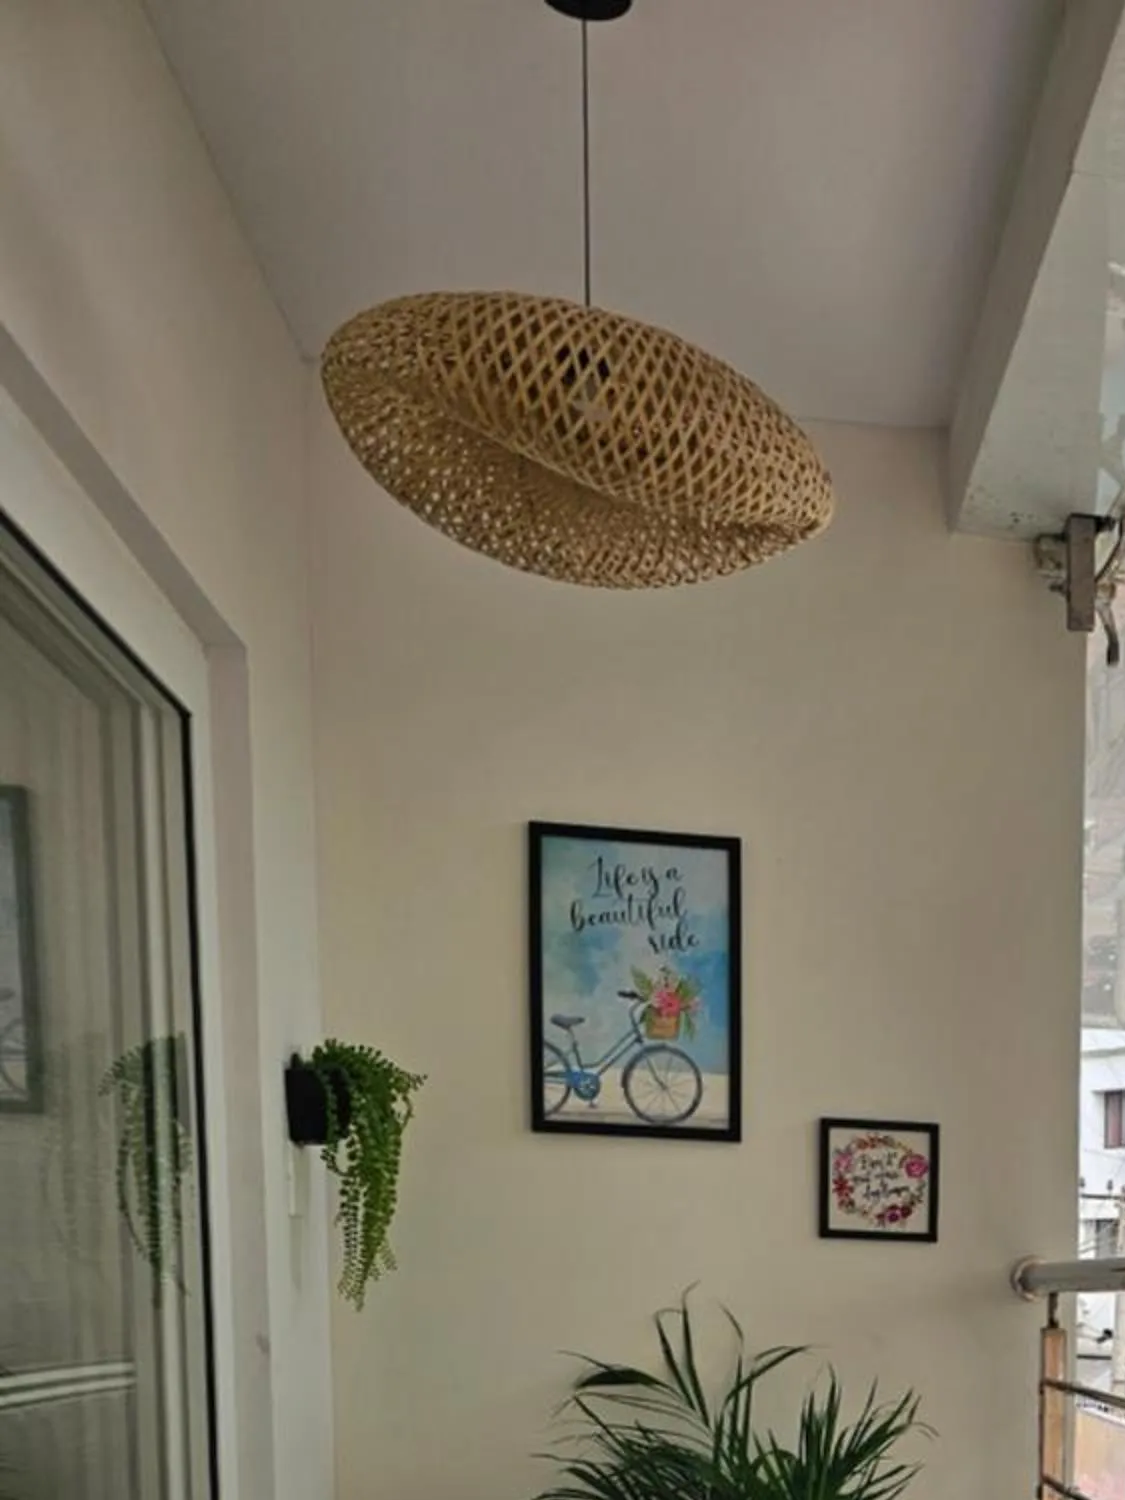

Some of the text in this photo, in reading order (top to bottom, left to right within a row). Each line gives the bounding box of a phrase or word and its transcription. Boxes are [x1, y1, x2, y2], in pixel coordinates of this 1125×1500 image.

[588, 856, 638, 899] Life
[665, 866, 684, 881] a
[570, 887, 688, 933] beautiful
[647, 916, 700, 954] ride
